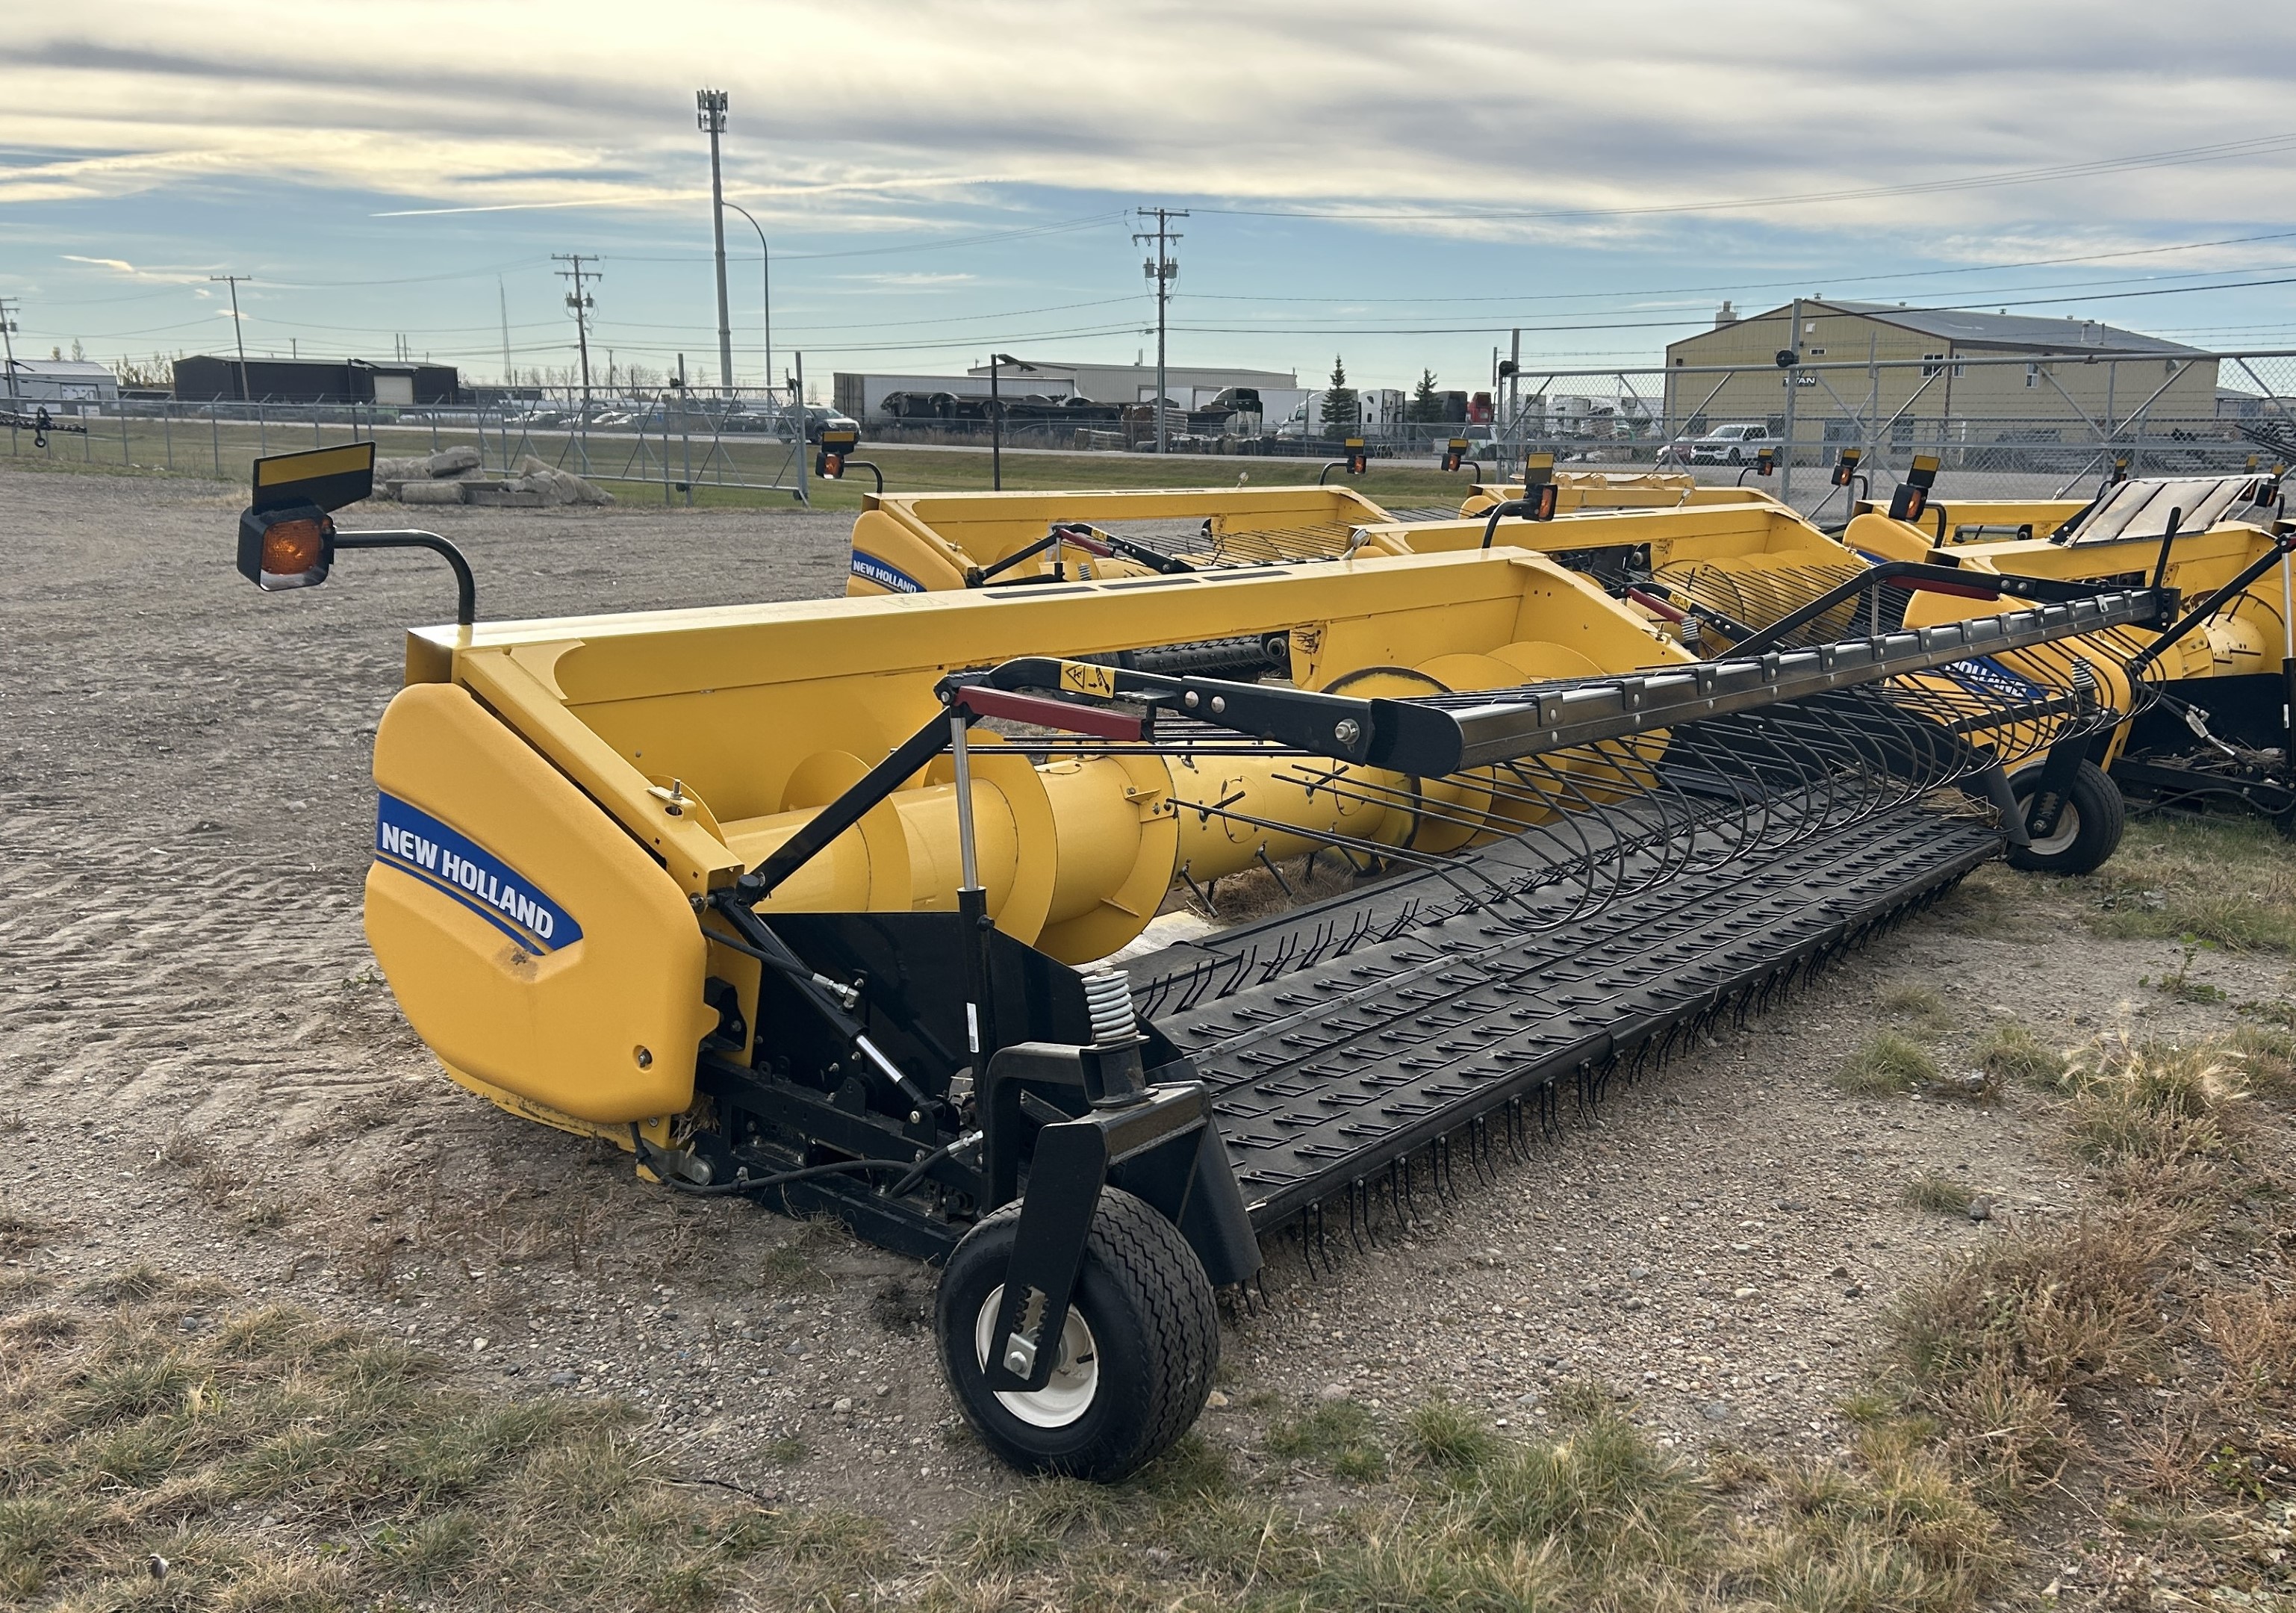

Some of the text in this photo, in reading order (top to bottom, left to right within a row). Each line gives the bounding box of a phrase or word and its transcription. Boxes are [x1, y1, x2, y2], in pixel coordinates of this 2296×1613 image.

[853, 560, 917, 593] NEW HOLLAND
[382, 821, 553, 939] NEW HOLLAND
